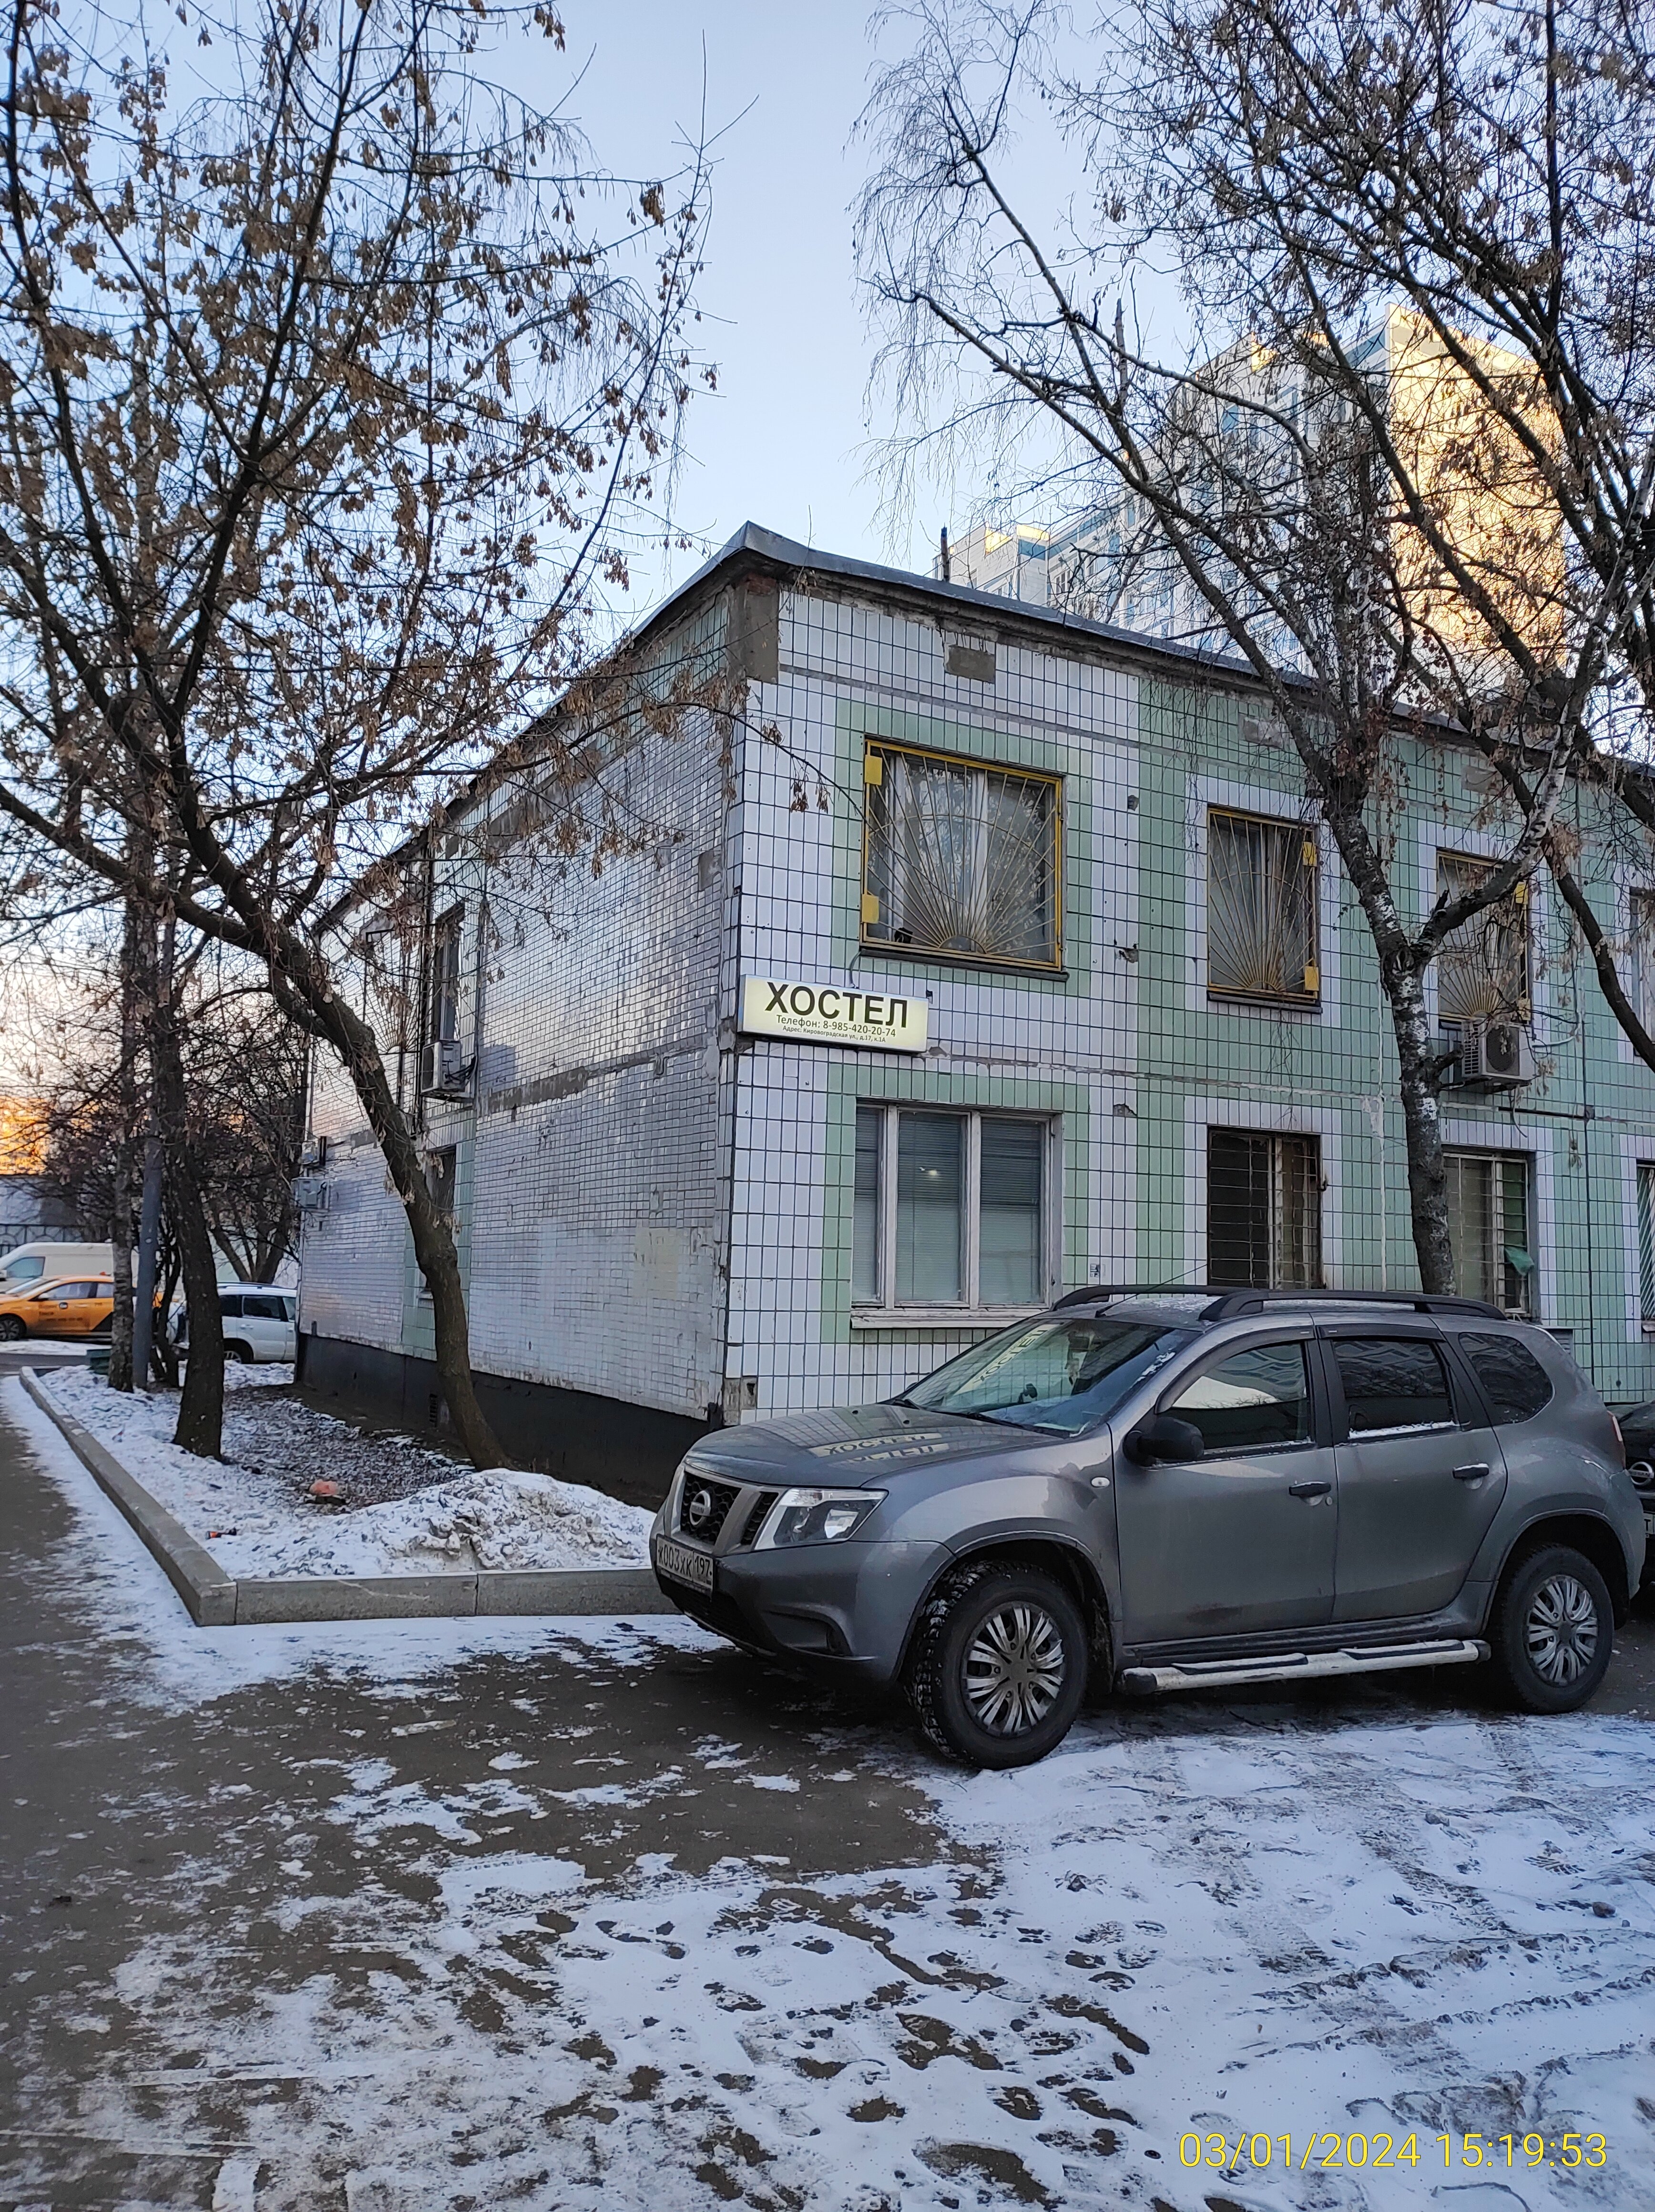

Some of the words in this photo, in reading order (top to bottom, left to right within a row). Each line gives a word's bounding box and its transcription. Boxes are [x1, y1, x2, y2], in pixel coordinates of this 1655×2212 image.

[765, 982, 908, 1028] ХОСТЕЛ
[776, 1014, 820, 1028] Телефон:
[823, 1021, 896, 1038] 8-985-420-20-74
[783, 1025, 802, 1034] Адрес:
[803, 1028, 848, 1038] Кировоградская
[695, 1556, 710, 1577] 197
